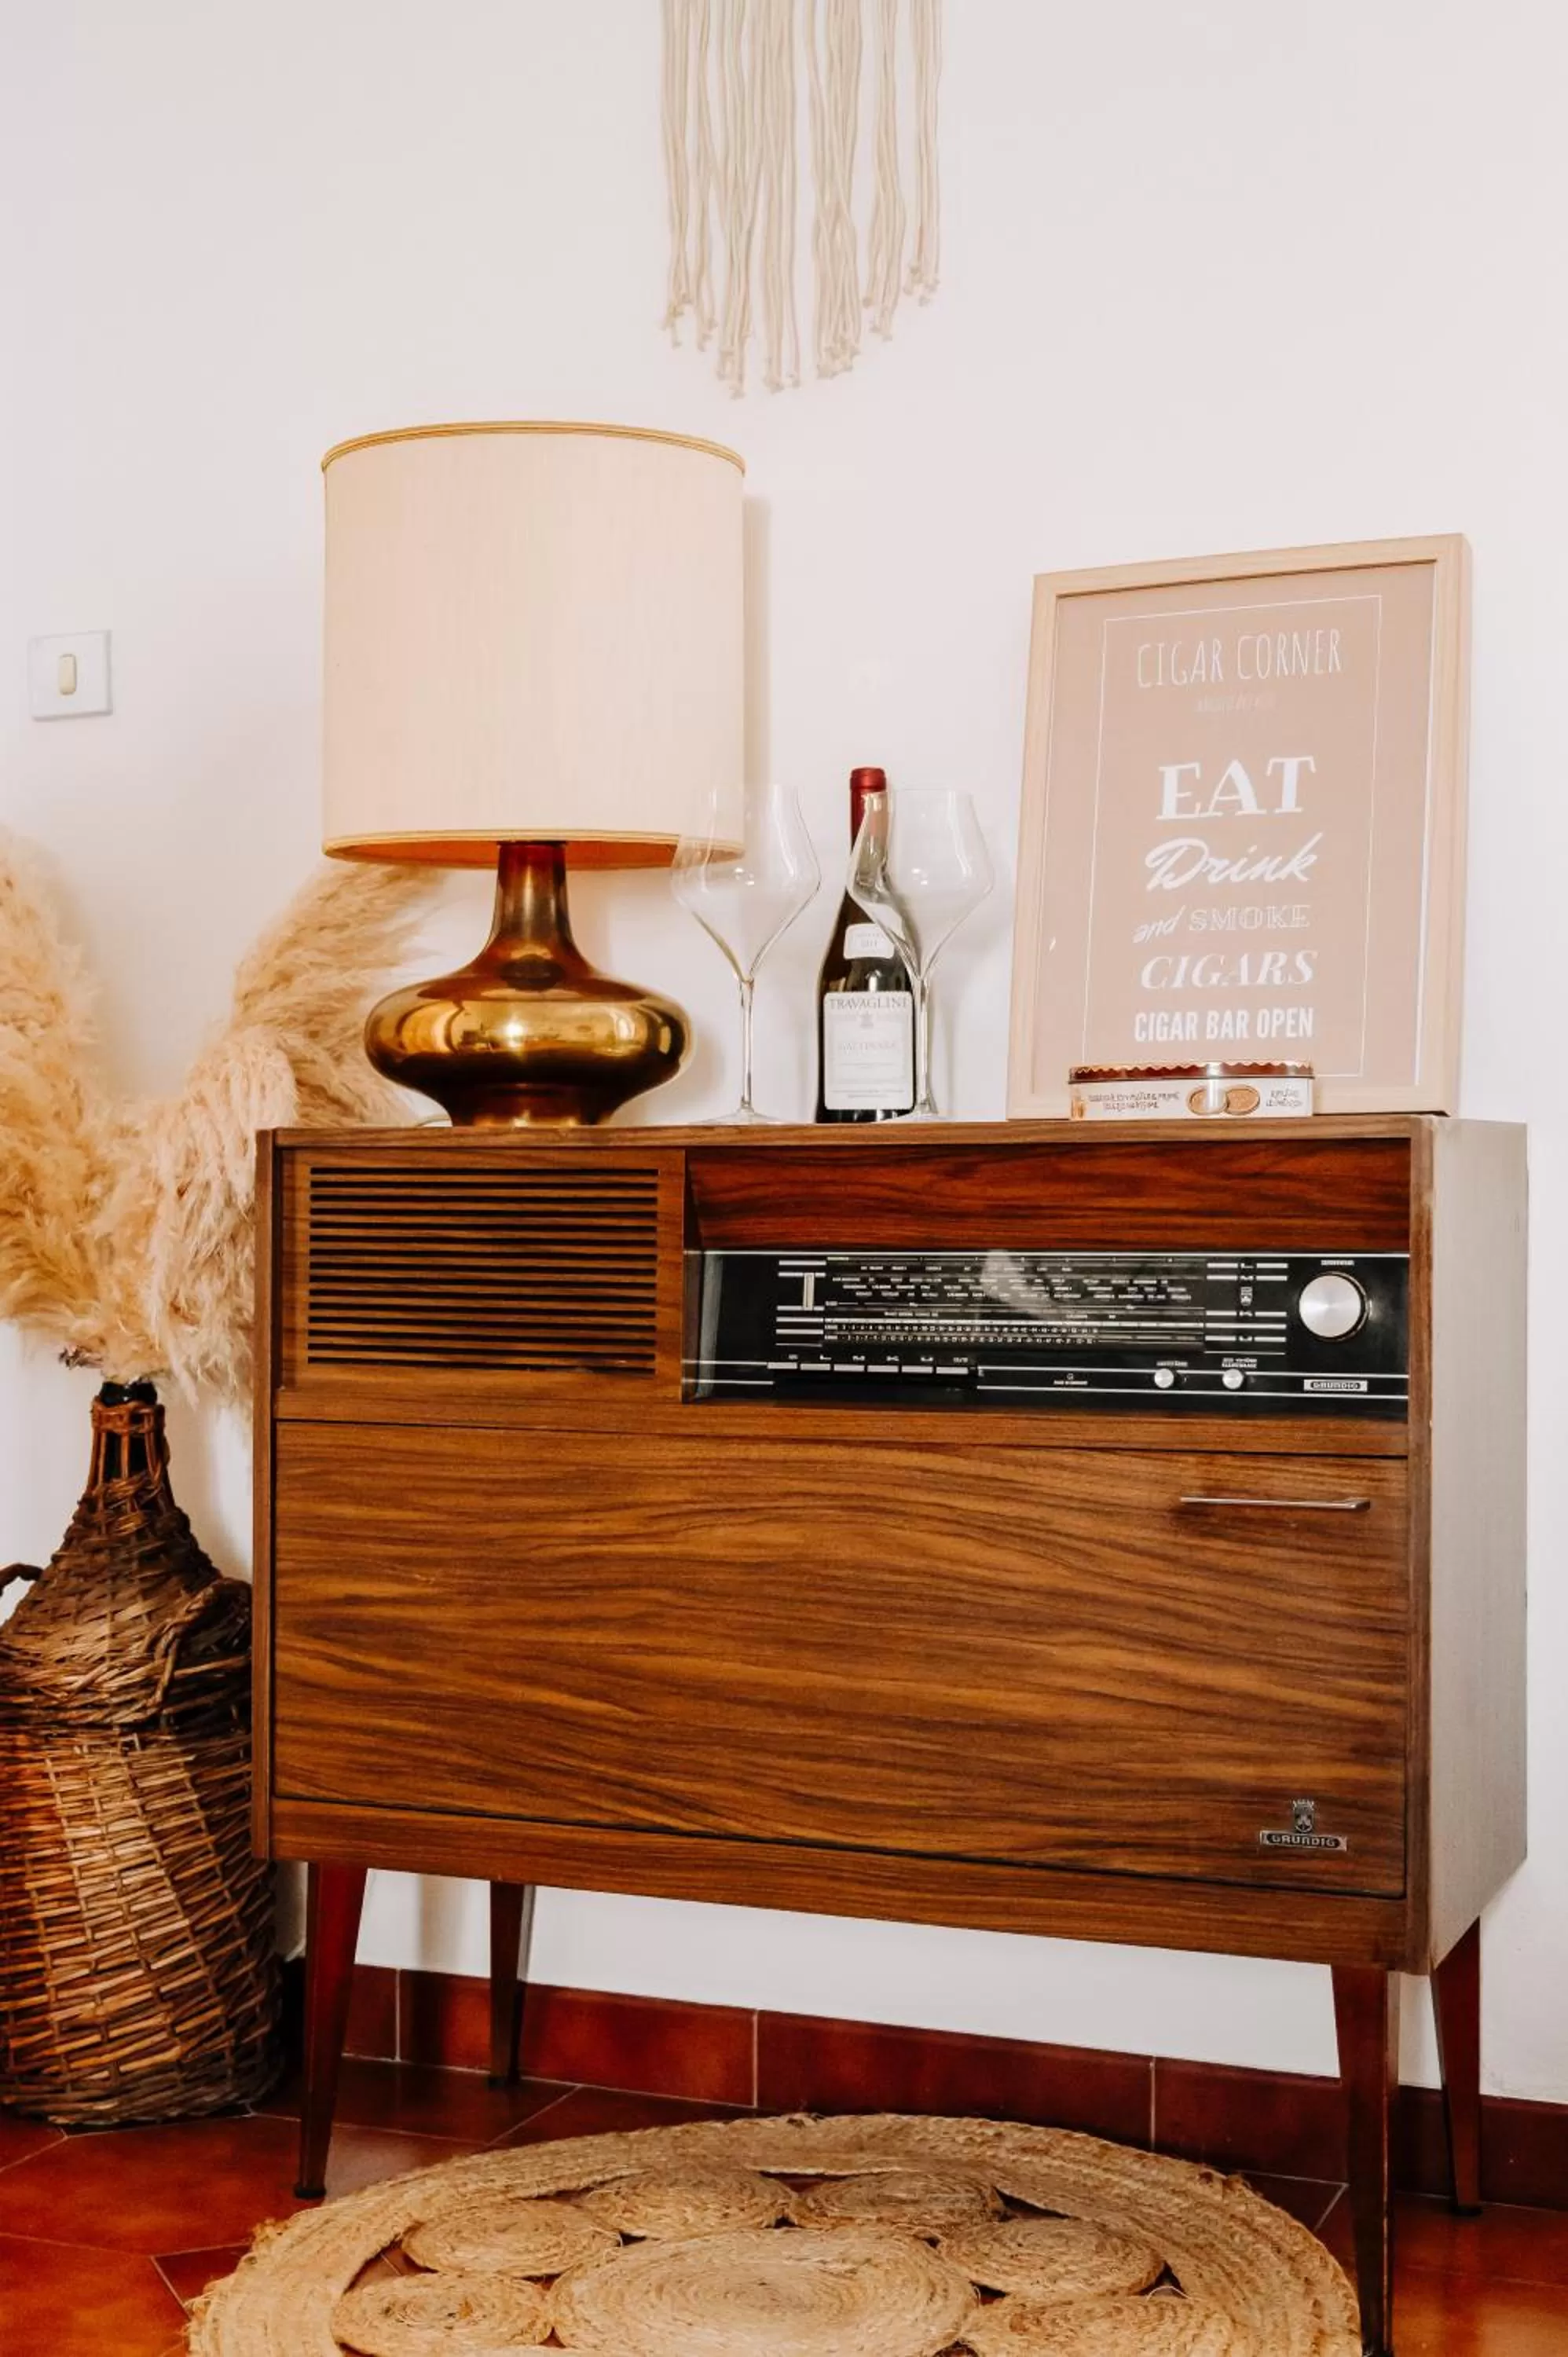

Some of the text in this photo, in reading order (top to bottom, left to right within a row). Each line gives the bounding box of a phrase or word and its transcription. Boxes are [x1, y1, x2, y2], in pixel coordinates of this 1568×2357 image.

[1138, 629, 1341, 688] CIGAR CORNER
[1156, 756, 1316, 820] EAT
[1145, 832, 1323, 891] Drink
[1132, 904, 1310, 944] and SMOKE
[1140, 949, 1319, 989] CIGARS
[830, 996, 907, 1010] TRAVAGLINI
[1134, 1006, 1314, 1043] CIGAR BAR OPEN
[1272, 1834, 1335, 1847] GRUNDIG
